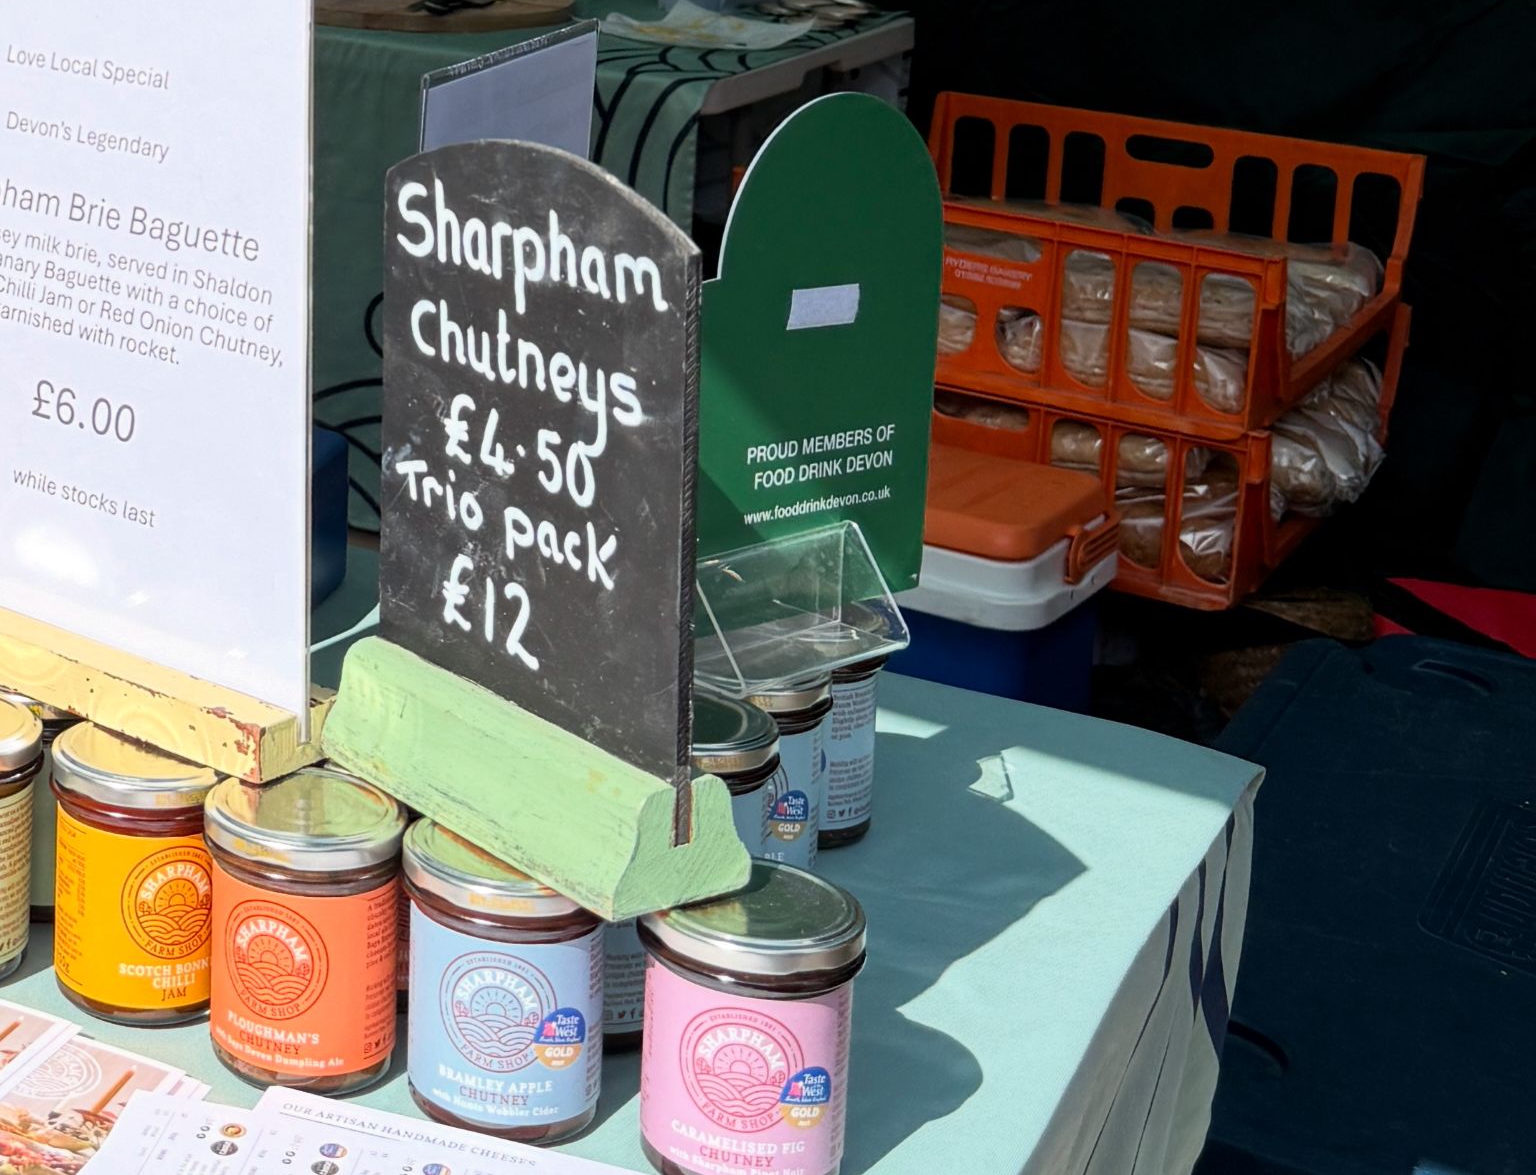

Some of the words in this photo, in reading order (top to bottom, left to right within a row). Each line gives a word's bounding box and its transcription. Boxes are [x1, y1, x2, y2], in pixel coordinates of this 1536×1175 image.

[6, 44, 46, 72] Love
[50, 50, 97, 79] Local
[102, 58, 170, 91] Special
[6, 110, 72, 143] Devon's
[76, 117, 170, 164] Legendary
[68, 192, 121, 232] Brie
[129, 206, 260, 262] Baguette
[395, 179, 669, 314] Sharpham
[24, 225, 61, 255] milk
[65, 239, 102, 268] brie,
[108, 249, 169, 282] served
[172, 263, 188, 285] in
[193, 267, 274, 307] Shaldon
[44, 259, 122, 298] Baguette
[126, 278, 164, 306] with
[168, 293, 180, 310] a
[184, 292, 249, 329] choice
[254, 313, 274, 334] of
[39, 284, 74, 311] Jam
[77, 297, 97, 315] or
[100, 299, 135, 327] Red
[140, 309, 194, 342] Onion
[199, 323, 285, 369] Chutney,
[78, 322, 115, 348] with
[119, 331, 181, 366] rocket.
[409, 299, 645, 457] Chutneys
[31, 378, 137, 443] £6.00
[746, 440, 799, 466] PROUD
[802, 427, 873, 455] MEMBERS
[876, 424, 896, 442] OF
[754, 466, 795, 490] FOOD
[799, 458, 843, 482] DRINK
[846, 450, 893, 474] DEVON
[13, 467, 57, 497] while
[61, 481, 118, 516] stocks
[123, 500, 156, 529] last
[395, 458, 484, 532] Trio
[744, 484, 891, 525] www.fooddrinkdevon.co.uk
[441, 553, 540, 672] £12
[777, 823, 801, 833] GOLD
[140, 864, 209, 900] SHARPHAM
[236, 918, 309, 963] SHARPHAM
[118, 962, 172, 977] SCOTCH
[152, 974, 196, 989] CHILLI
[457, 969, 538, 1011] SHARPHAM
[162, 987, 187, 1002] JAM
[227, 1009, 321, 1045] PLOUGHMAN'S
[239, 1030, 301, 1055] CHUTNEY
[275, 1053, 326, 1069] Dumpling
[544, 1046, 574, 1058] GOLD
[697, 1026, 785, 1070] SHARPHAM
[438, 1063, 505, 1092] BRAMLEY
[508, 1080, 553, 1094] APPLE
[459, 1085, 530, 1106] CHUTNEY
[802, 1084, 824, 1097] West
[804, 1073, 826, 1085] Taste
[702, 1102, 738, 1128] FARM
[741, 1113, 775, 1130] SHOP
[790, 1106, 820, 1118] GOLD
[282, 1101, 312, 1117] OUR
[317, 1109, 379, 1132] ARTISAN
[380, 1124, 468, 1152] HANDMADE
[470, 1146, 537, 1167] CHEESES
[671, 1119, 776, 1155] CARAMELISED
[781, 1141, 805, 1153] FIG
[699, 1145, 775, 1168] CHUTNEY
